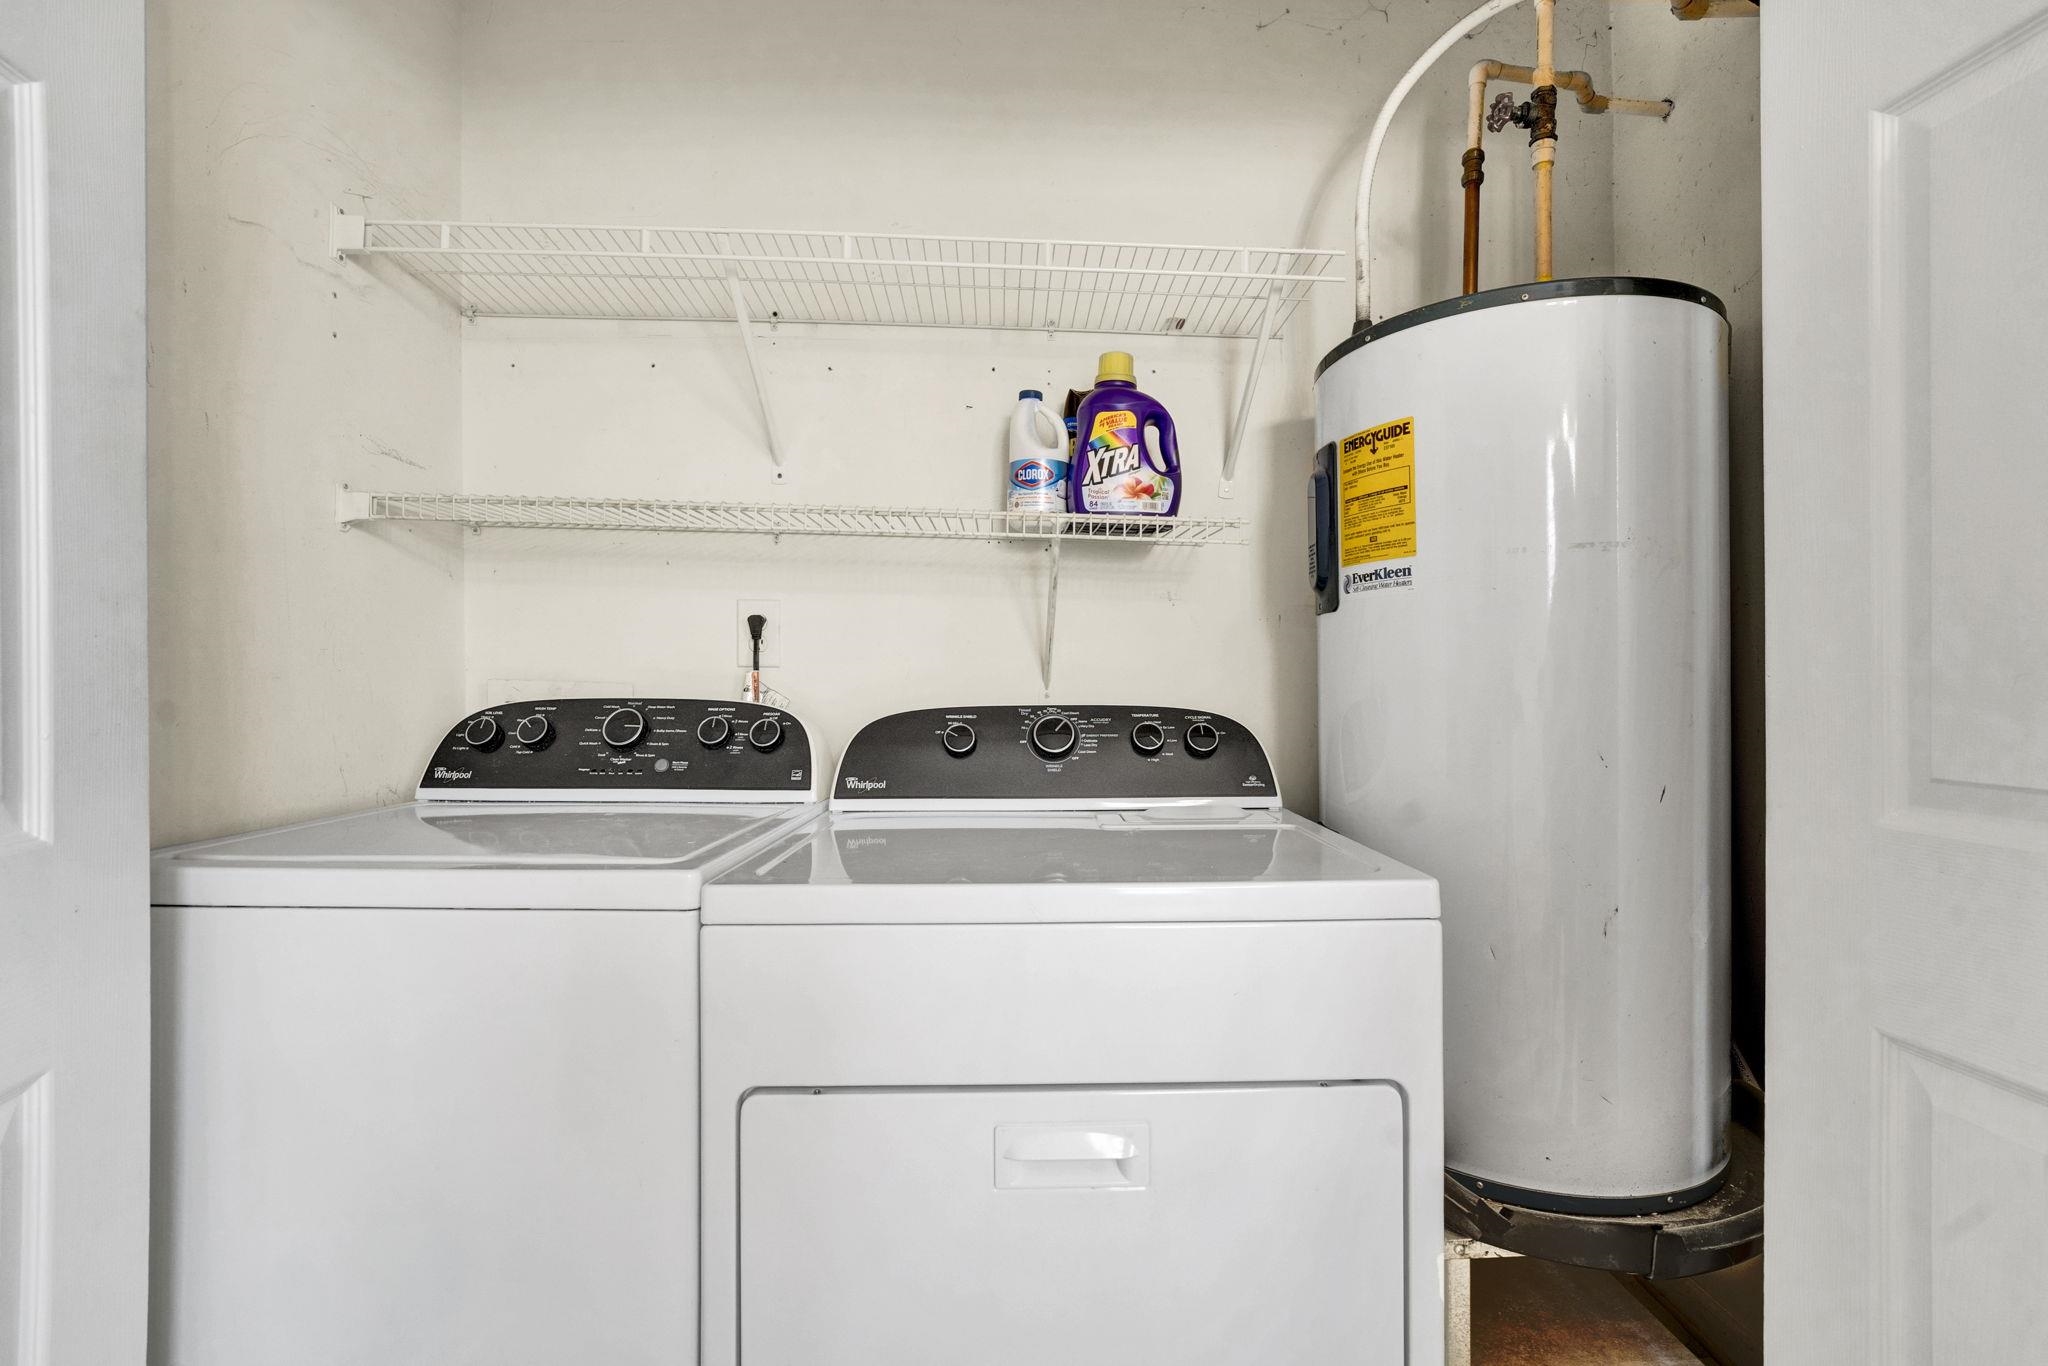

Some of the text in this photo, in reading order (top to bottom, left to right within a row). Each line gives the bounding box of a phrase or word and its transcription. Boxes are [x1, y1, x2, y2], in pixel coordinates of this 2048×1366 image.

[1344, 421, 1411, 454] ENERGYGUIDE
[1082, 444, 1140, 486] XTRA
[1017, 468, 1050, 481] CLOROX
[1352, 566, 1412, 584] EverKleen
[434, 769, 473, 781] Whirlpool
[846, 780, 886, 791] Whirlpool
